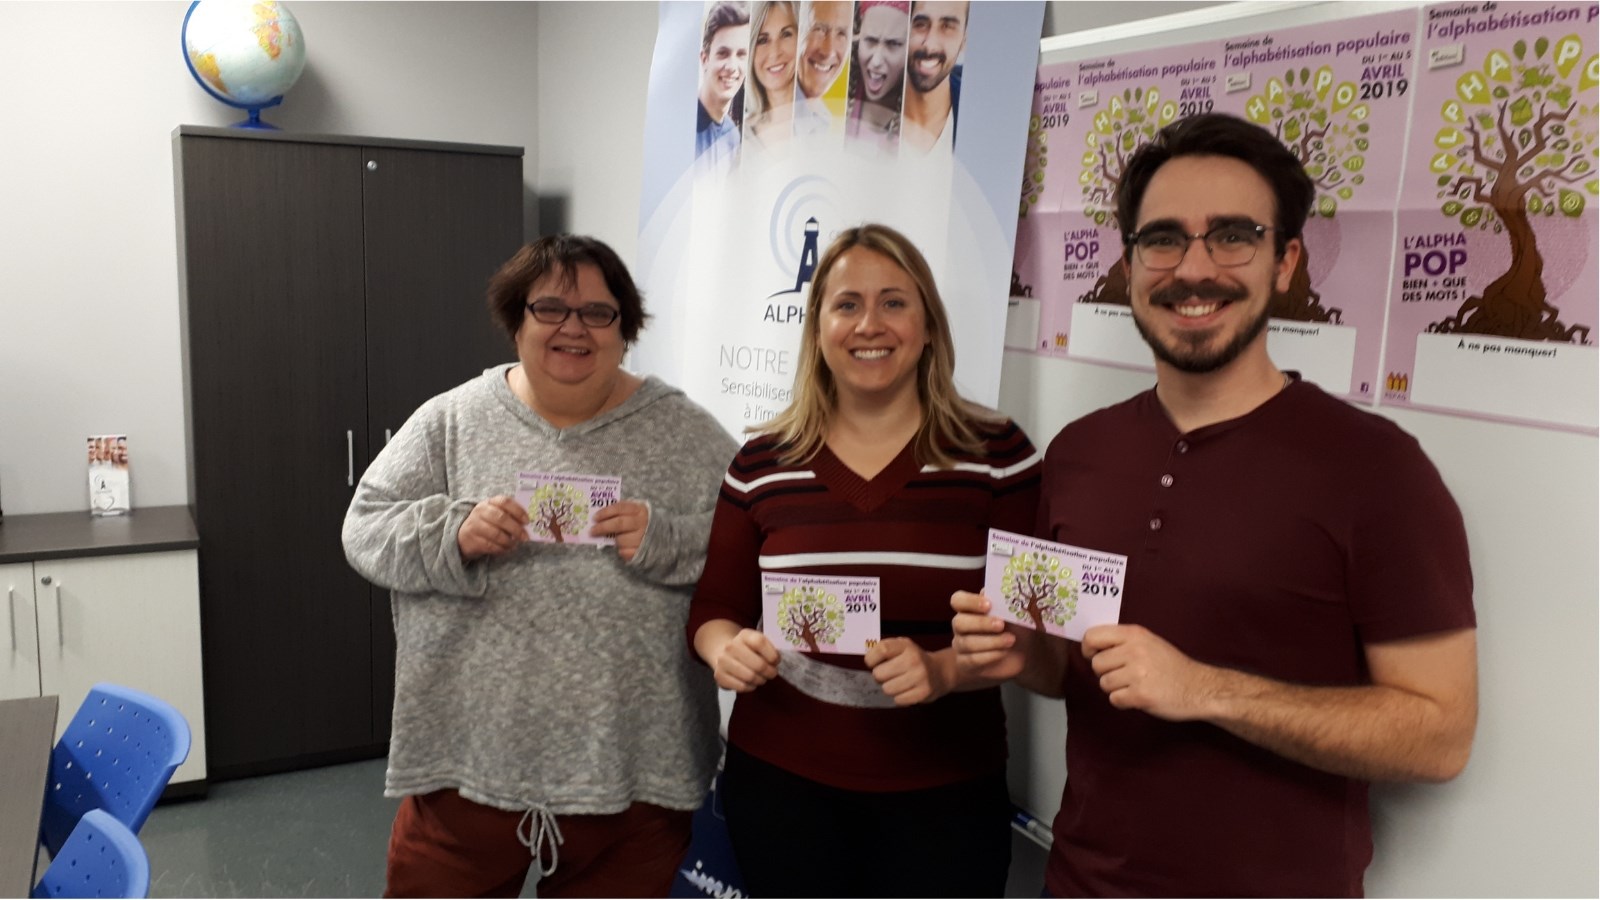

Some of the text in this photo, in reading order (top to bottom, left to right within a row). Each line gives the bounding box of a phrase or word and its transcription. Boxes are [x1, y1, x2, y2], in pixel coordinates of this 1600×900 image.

[1429, 1, 1497, 20] Semaine de
[1427, 6, 1580, 40] l'alphabétisation
[1224, 30, 1410, 68] l'alphabétisation populaire
[1226, 35, 1273, 50] Semaine de
[1078, 58, 1216, 86] l'alphabétisation populaire
[1360, 63, 1404, 81] AVRIL
[1180, 86, 1210, 100] AVRIL
[1360, 79, 1408, 100] 2019
[1043, 103, 1066, 114] AVRIL
[1180, 100, 1214, 116] 2019
[1042, 114, 1070, 128] 2019
[1064, 229, 1098, 241] L'ALPHA
[1404, 232, 1467, 250] L'ALPHA
[1065, 241, 1099, 261] POP
[1404, 250, 1467, 277] POP
[1402, 279, 1427, 290] BIEN
[1442, 277, 1467, 288] QUE
[1402, 291, 1421, 302] DES
[1425, 289, 1458, 301] MOTS
[1468, 342, 1480, 350] ne
[1483, 344, 1501, 354] pas
[1504, 345, 1557, 359] manquer!
[719, 345, 789, 375] NOTRE
[744, 403, 751, 418] à
[992, 533, 1019, 544] Semaine
[1030, 541, 1088, 559] l'alphabétisation
[1089, 554, 1124, 566] populaire
[1081, 572, 1115, 584] AVRIL
[1081, 582, 1119, 597] 2019
[845, 594, 873, 603] AVRIL
[846, 602, 877, 613] 2019
